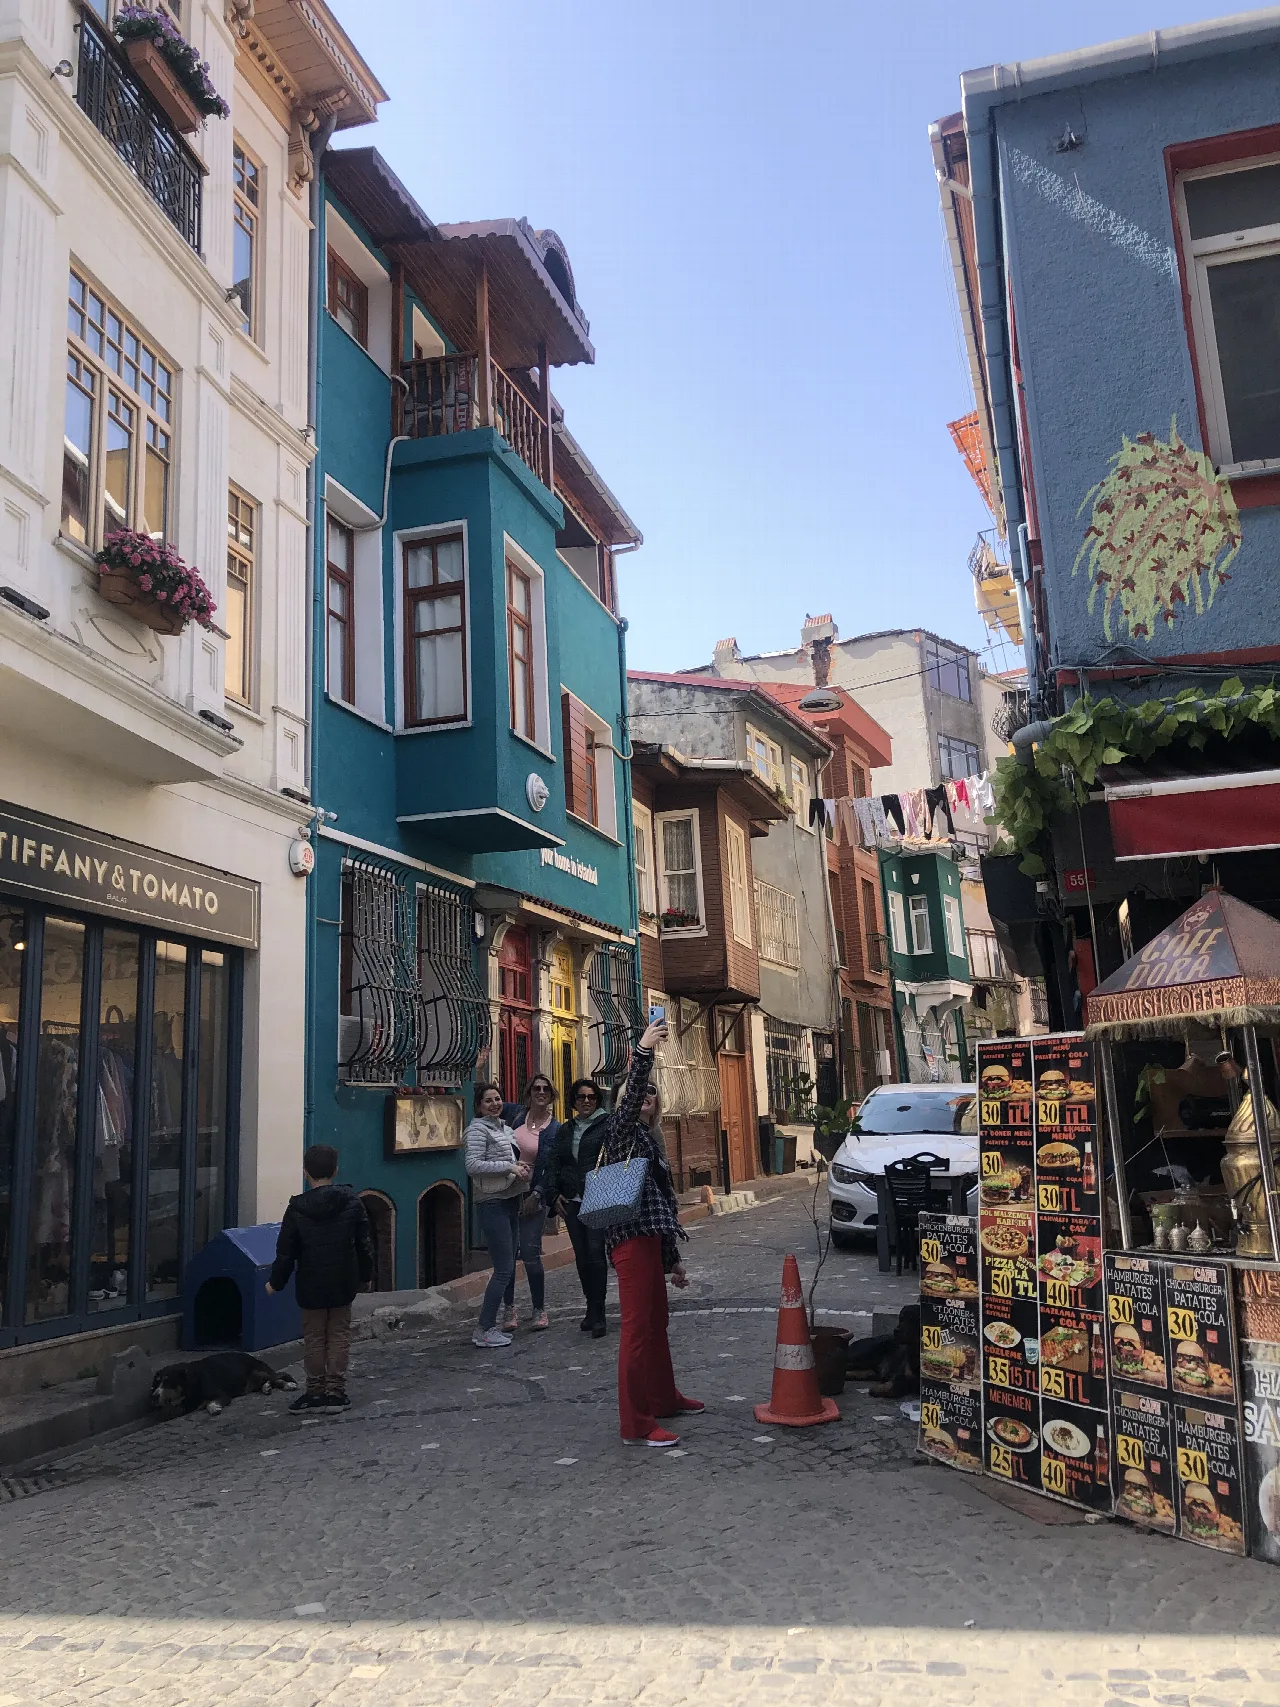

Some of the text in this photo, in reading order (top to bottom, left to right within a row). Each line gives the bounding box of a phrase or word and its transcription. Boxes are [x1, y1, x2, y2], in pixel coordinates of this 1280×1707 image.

[0, 831, 219, 915] TIFFANY & TOMATO
[106, 893, 128, 904] BALAT
[1141, 927, 1223, 962] CAFE
[1125, 955, 1212, 989] DORA
[1100, 985, 1233, 1022] TURKISH COFFEE
[982, 1102, 1030, 1124] 30 TL
[1039, 1103, 1087, 1124] 30 TL
[983, 1154, 1000, 1174] 30
[1040, 1187, 1081, 1211] 30 TL
[927, 1231, 968, 1245] PATATES
[922, 1241, 939, 1261] 30
[992, 1273, 1038, 1297] 50 TL
[1048, 1282, 1087, 1307] 40 TL
[1114, 1281, 1152, 1300] PATATES
[1110, 1297, 1133, 1323] 30
[1174, 1291, 1217, 1311] PATATES
[938, 1314, 976, 1328] PATATES
[1059, 1317, 1087, 1331] COLA
[1080, 1312, 1104, 1323] TOST
[1169, 1310, 1194, 1338] 30
[923, 1327, 940, 1349] 30
[989, 1359, 1039, 1390] 35 15 TL
[1042, 1370, 1090, 1404] 25 TL
[929, 1396, 973, 1417] PATATES
[989, 1388, 1032, 1412] MENEMEN
[922, 1405, 939, 1428] 30
[1243, 1400, 1280, 1443] SA
[1122, 1419, 1160, 1443] PATATES
[1120, 1438, 1142, 1466] 30
[1185, 1435, 1230, 1461] PATATES
[992, 1445, 1028, 1481] 25 TL
[1043, 1461, 1064, 1489] 40
[1180, 1452, 1205, 1481] 30
